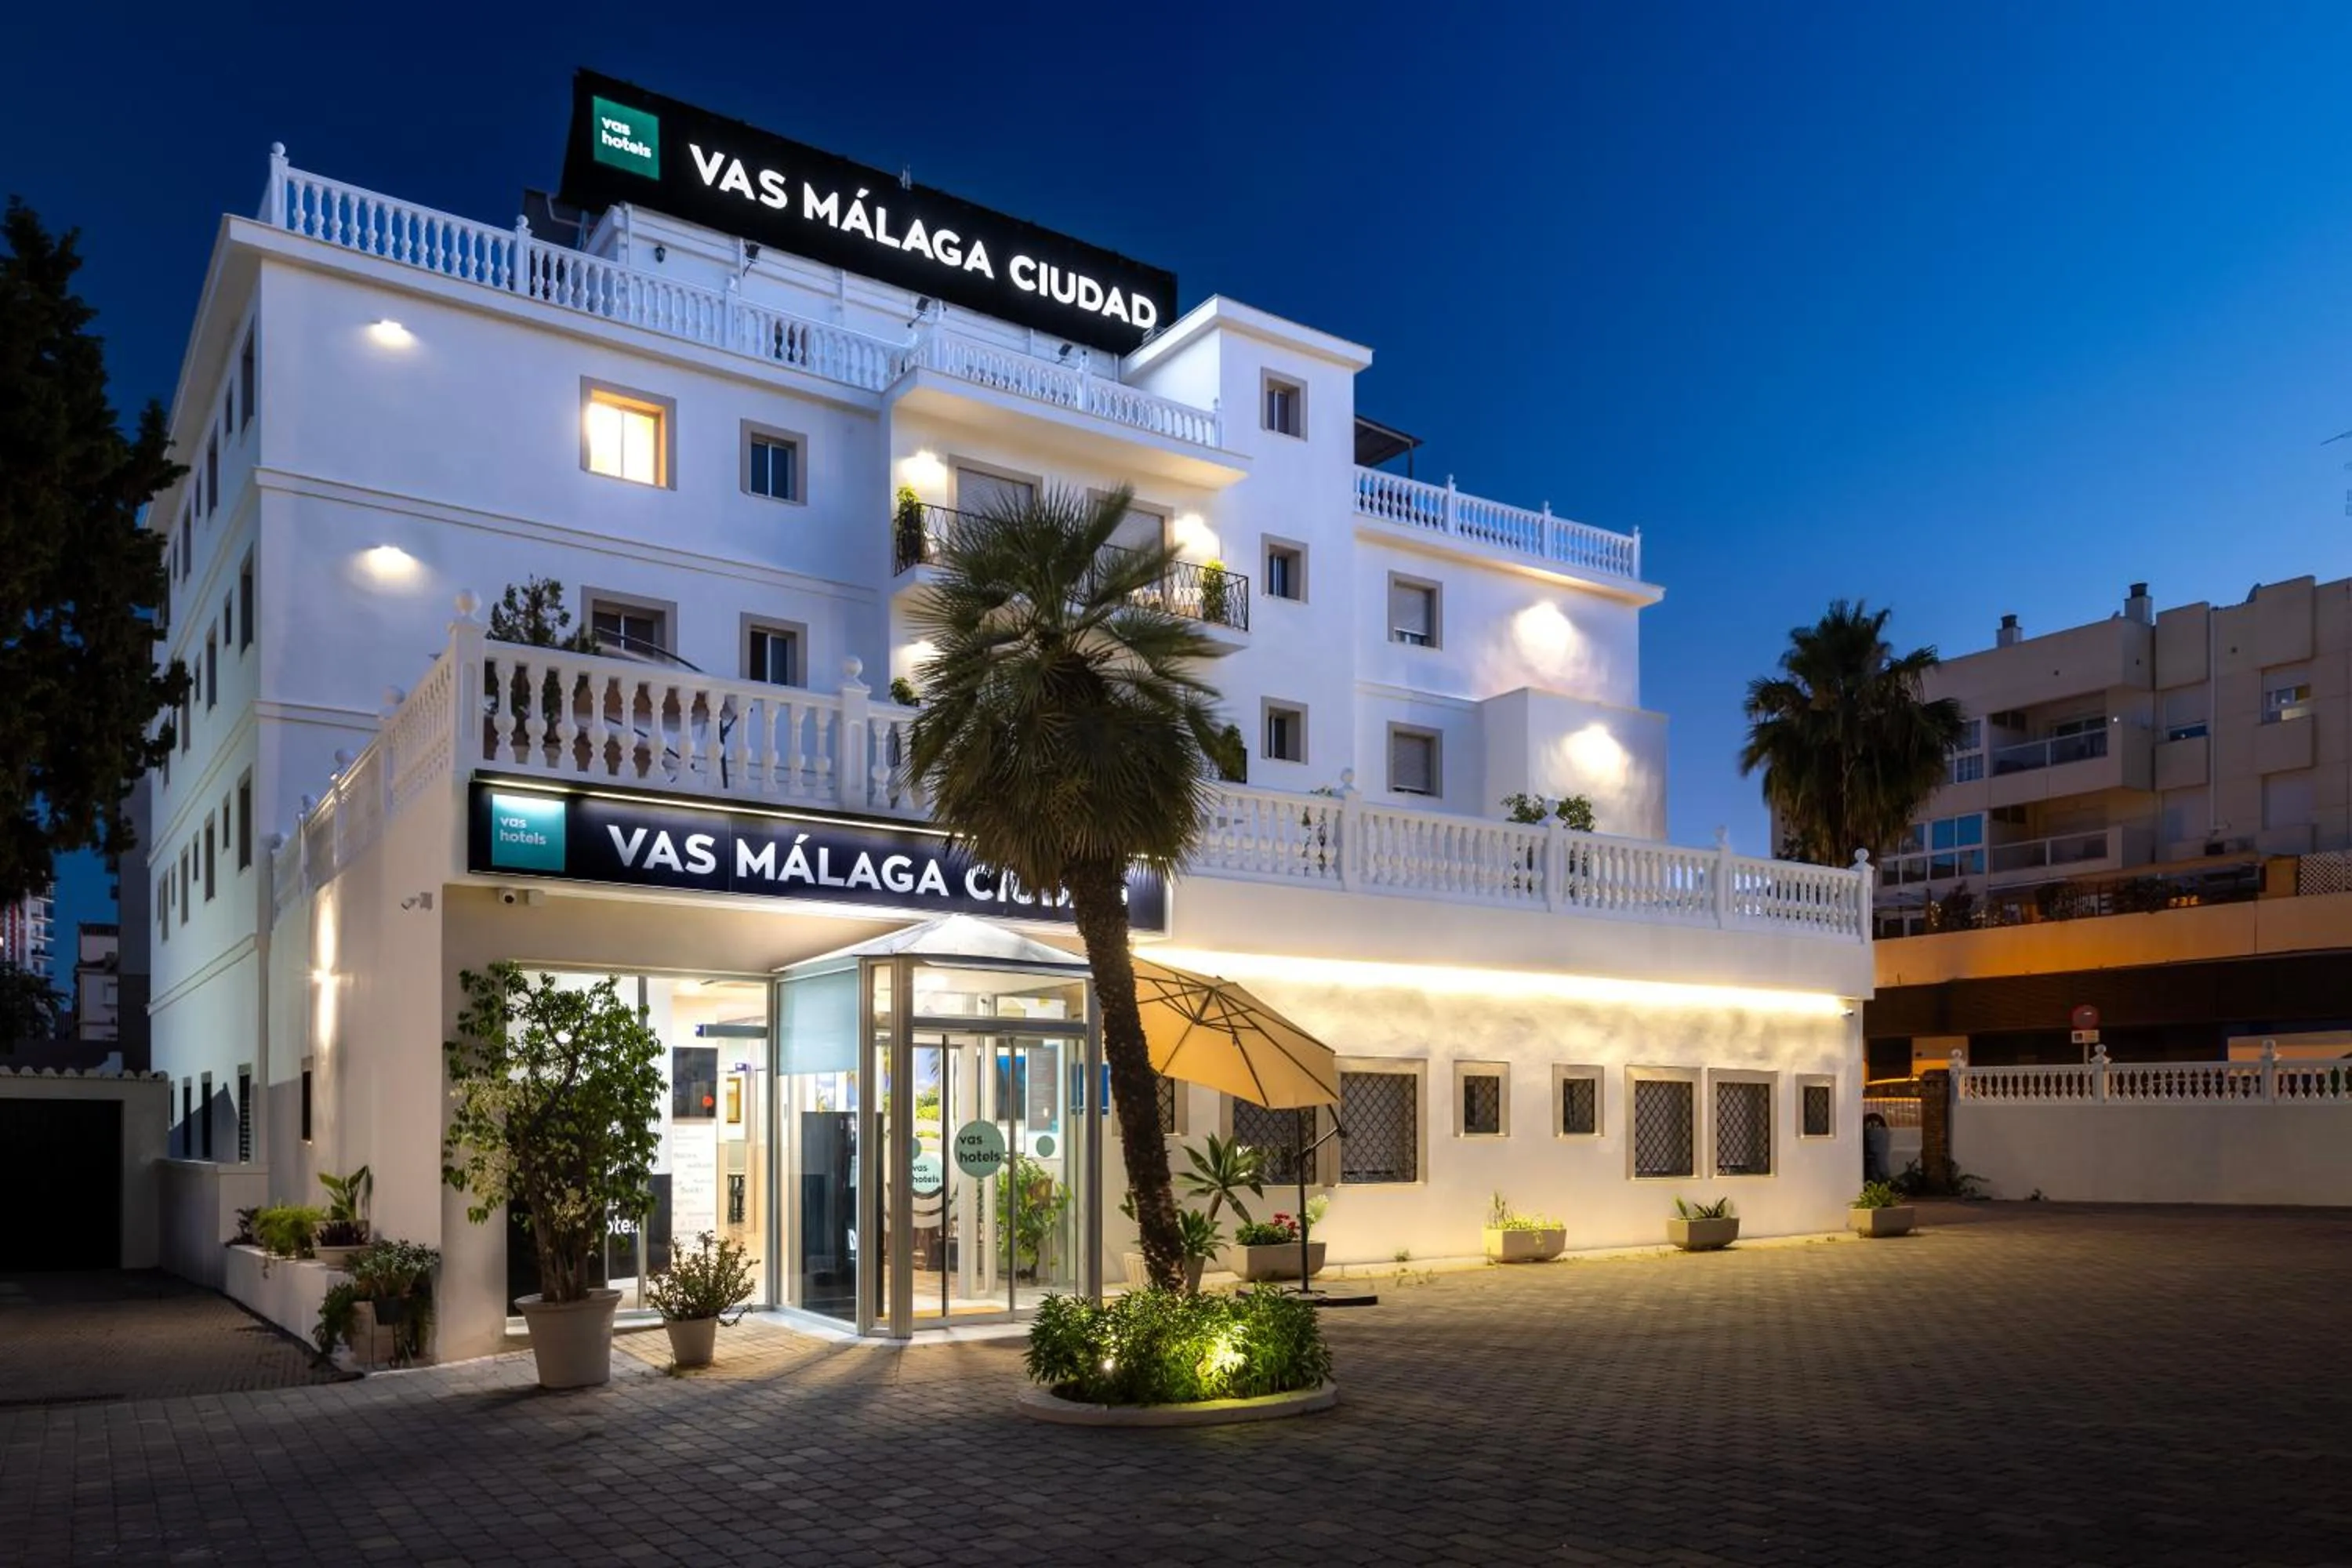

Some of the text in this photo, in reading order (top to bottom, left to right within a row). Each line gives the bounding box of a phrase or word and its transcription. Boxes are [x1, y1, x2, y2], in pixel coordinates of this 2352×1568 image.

[601, 117, 630, 136] vas
[601, 129, 652, 158] hotels
[689, 143, 1158, 329] VAS MÁLAGA CIUDAD
[499, 816, 527, 829] vas
[499, 829, 546, 845] hotels
[606, 824, 717, 874] VAS
[736, 833, 949, 897] MÁLAGA
[959, 1135, 983, 1145] vas
[959, 1150, 1000, 1163] hotels
